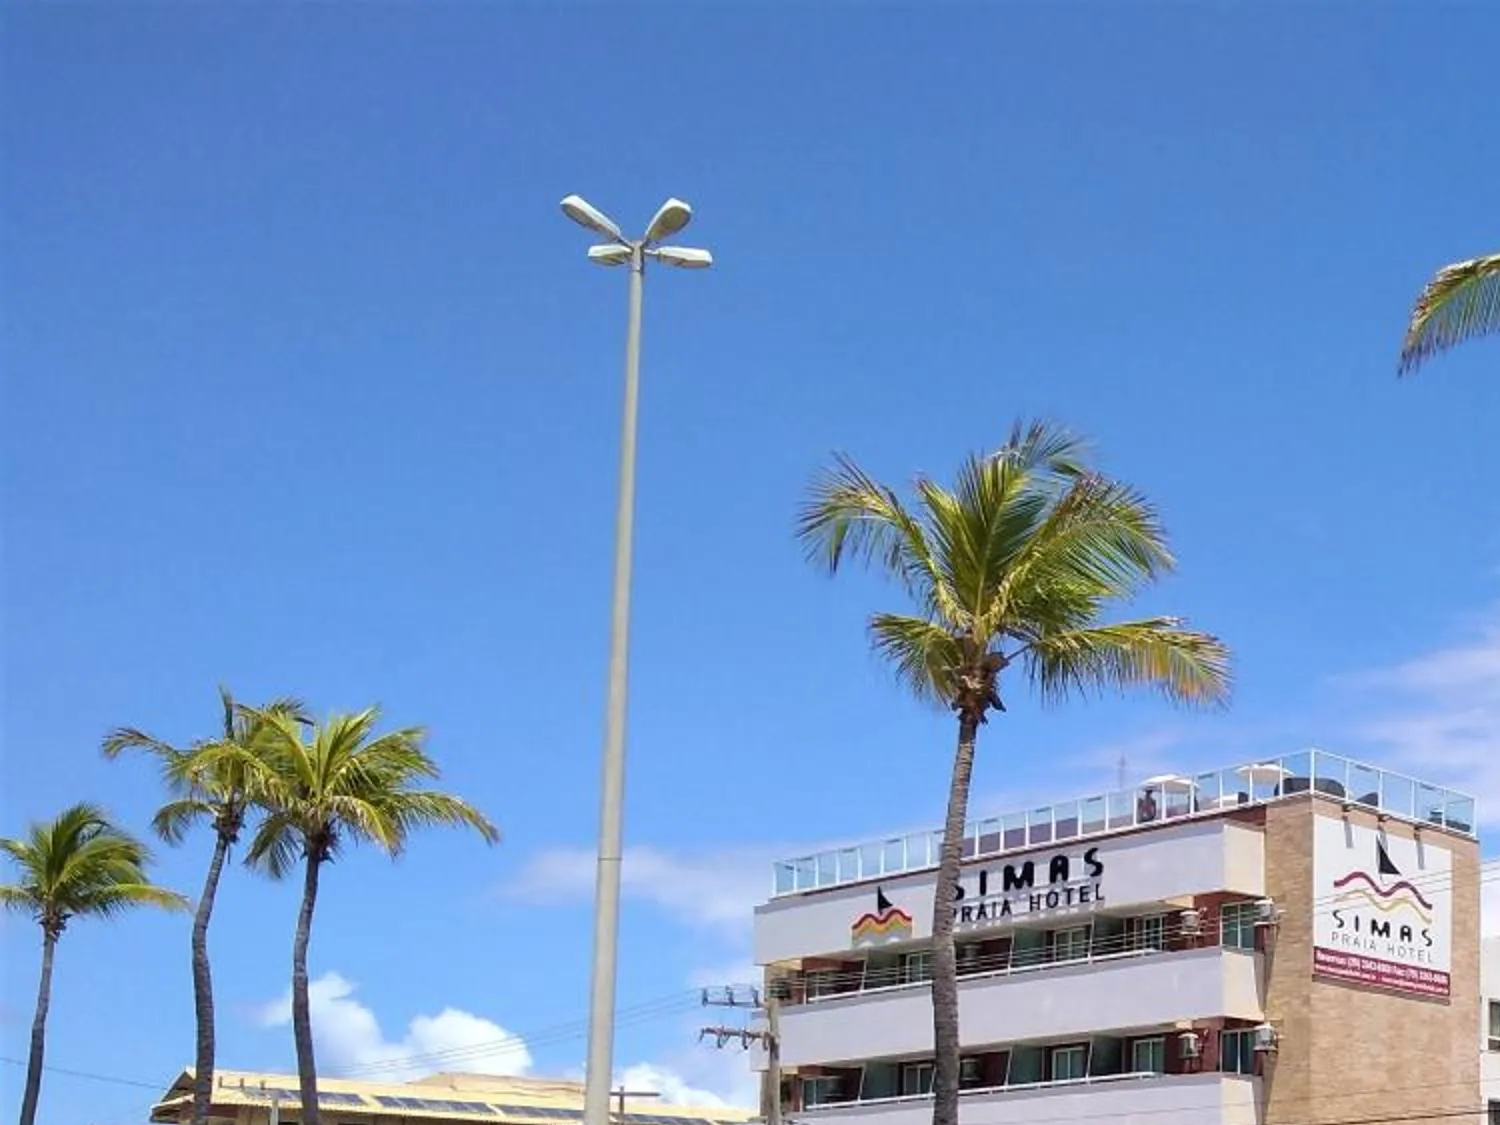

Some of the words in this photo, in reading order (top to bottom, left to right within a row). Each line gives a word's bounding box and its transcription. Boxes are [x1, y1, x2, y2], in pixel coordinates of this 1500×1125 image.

[952, 900, 1012, 924] RAIA
[1029, 883, 1105, 913] HOTEL
[1331, 931, 1377, 950] PRAIA
[1387, 943, 1432, 963] HOTEL
[1332, 909, 1433, 947] SIMAS
